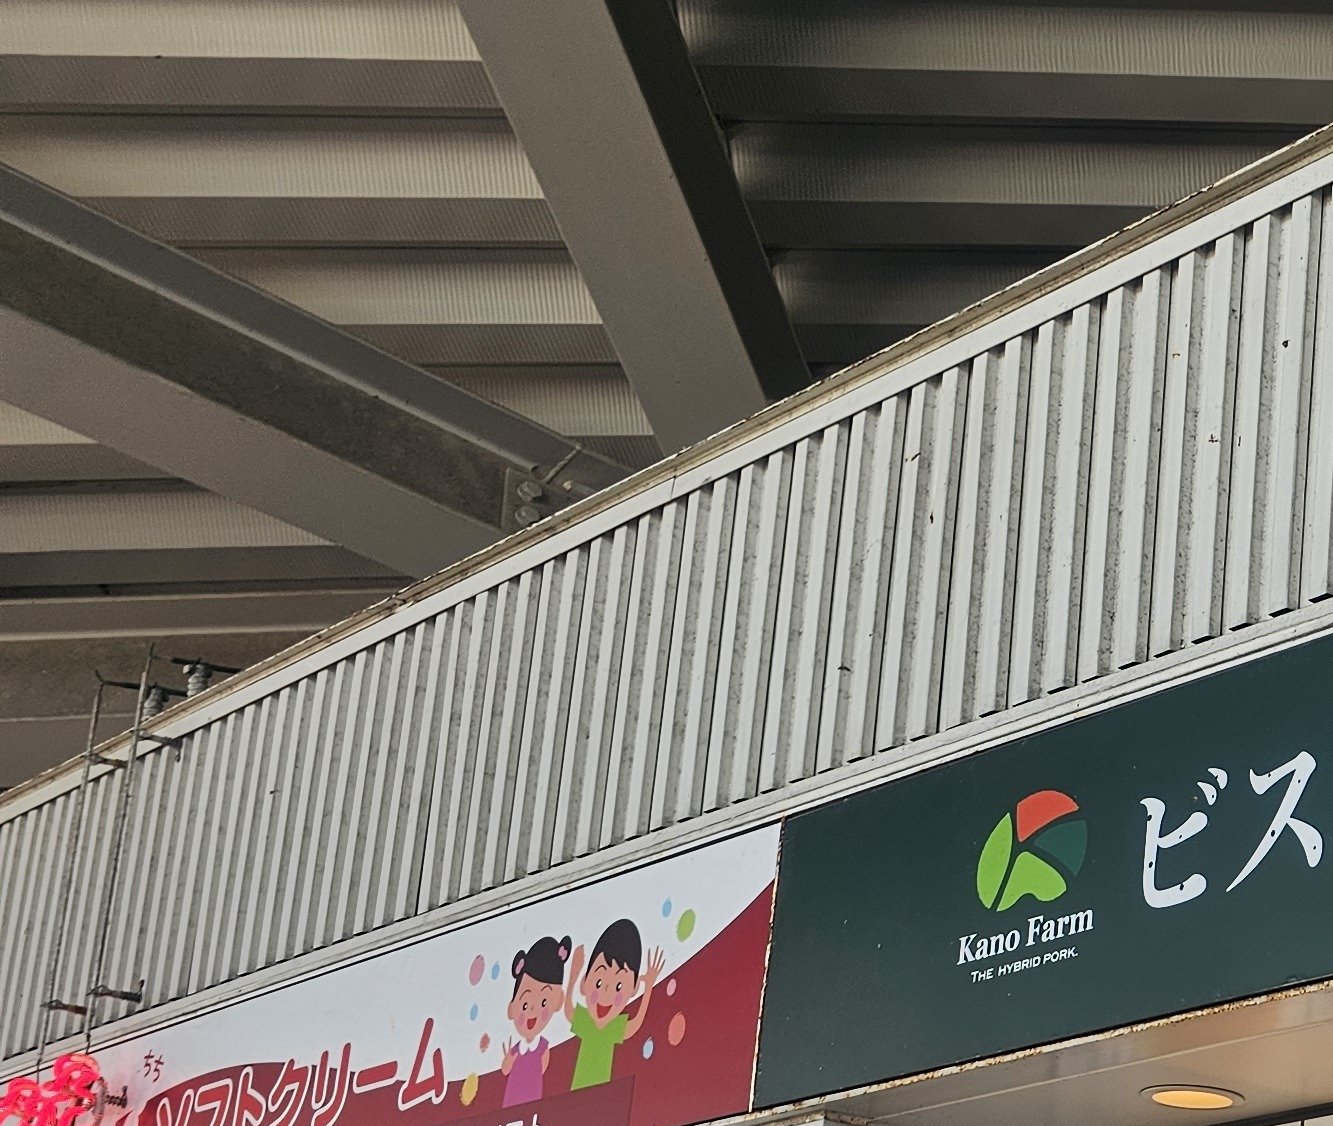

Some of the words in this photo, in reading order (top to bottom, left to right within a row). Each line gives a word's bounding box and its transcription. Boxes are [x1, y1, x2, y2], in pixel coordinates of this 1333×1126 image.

[957, 929, 1021, 965] Kano
[1025, 908, 1094, 947] Farm
[970, 968, 994, 983] THE
[998, 956, 1041, 977] HYBRID
